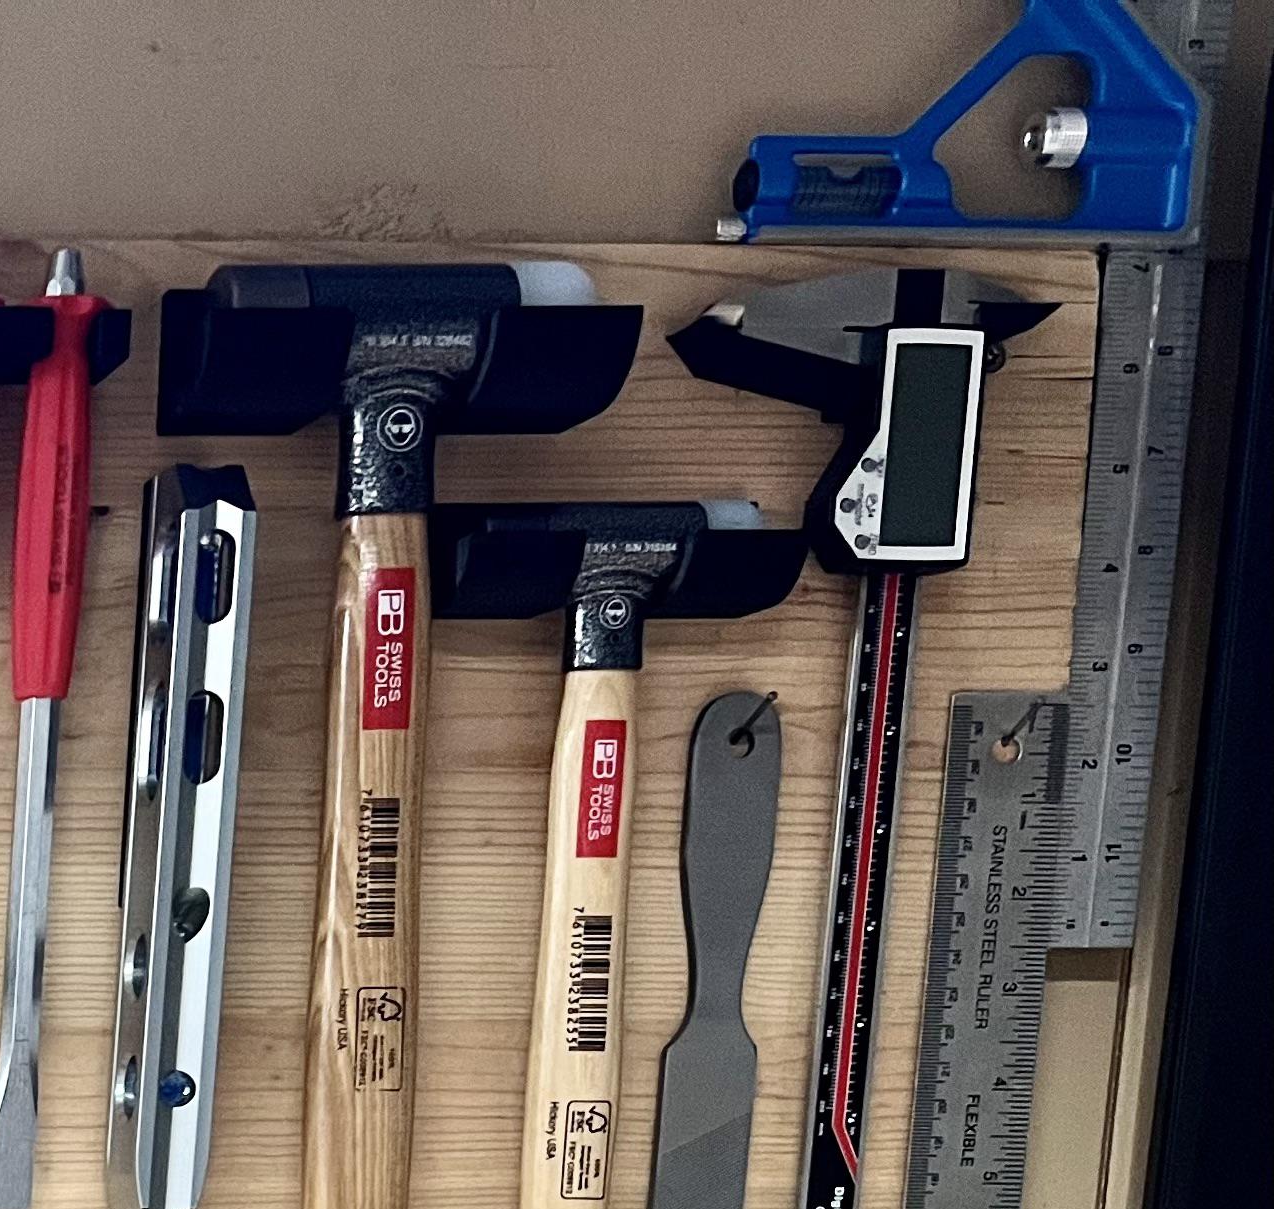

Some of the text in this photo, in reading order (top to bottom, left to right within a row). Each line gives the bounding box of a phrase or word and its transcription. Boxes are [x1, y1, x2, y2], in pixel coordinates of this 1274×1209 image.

[377, 589, 404, 636] PB
[373, 641, 391, 709] TOOLS
[389, 641, 403, 702] SWISS
[1090, 660, 1108, 673] 3
[592, 739, 618, 779] PB
[1081, 758, 1097, 770] 2
[1115, 743, 1133, 763] 10
[587, 783, 603, 841] TOOLS
[600, 784, 614, 836] SWISS
[1104, 843, 1122, 863] 11
[1012, 886, 1026, 899] 2
[974, 824, 1008, 1030] STAINLESS STEEL RULER
[569, 921, 583, 979] 610733
[1002, 981, 1016, 994] 3
[367, 997, 377, 1022] FSC
[566, 986, 580, 1045] 238255
[337, 1027, 347, 1050] USA
[576, 1111, 585, 1133] FSC
[960, 1094, 981, 1168] FLEXIBLE
[545, 1137, 557, 1160] USA
